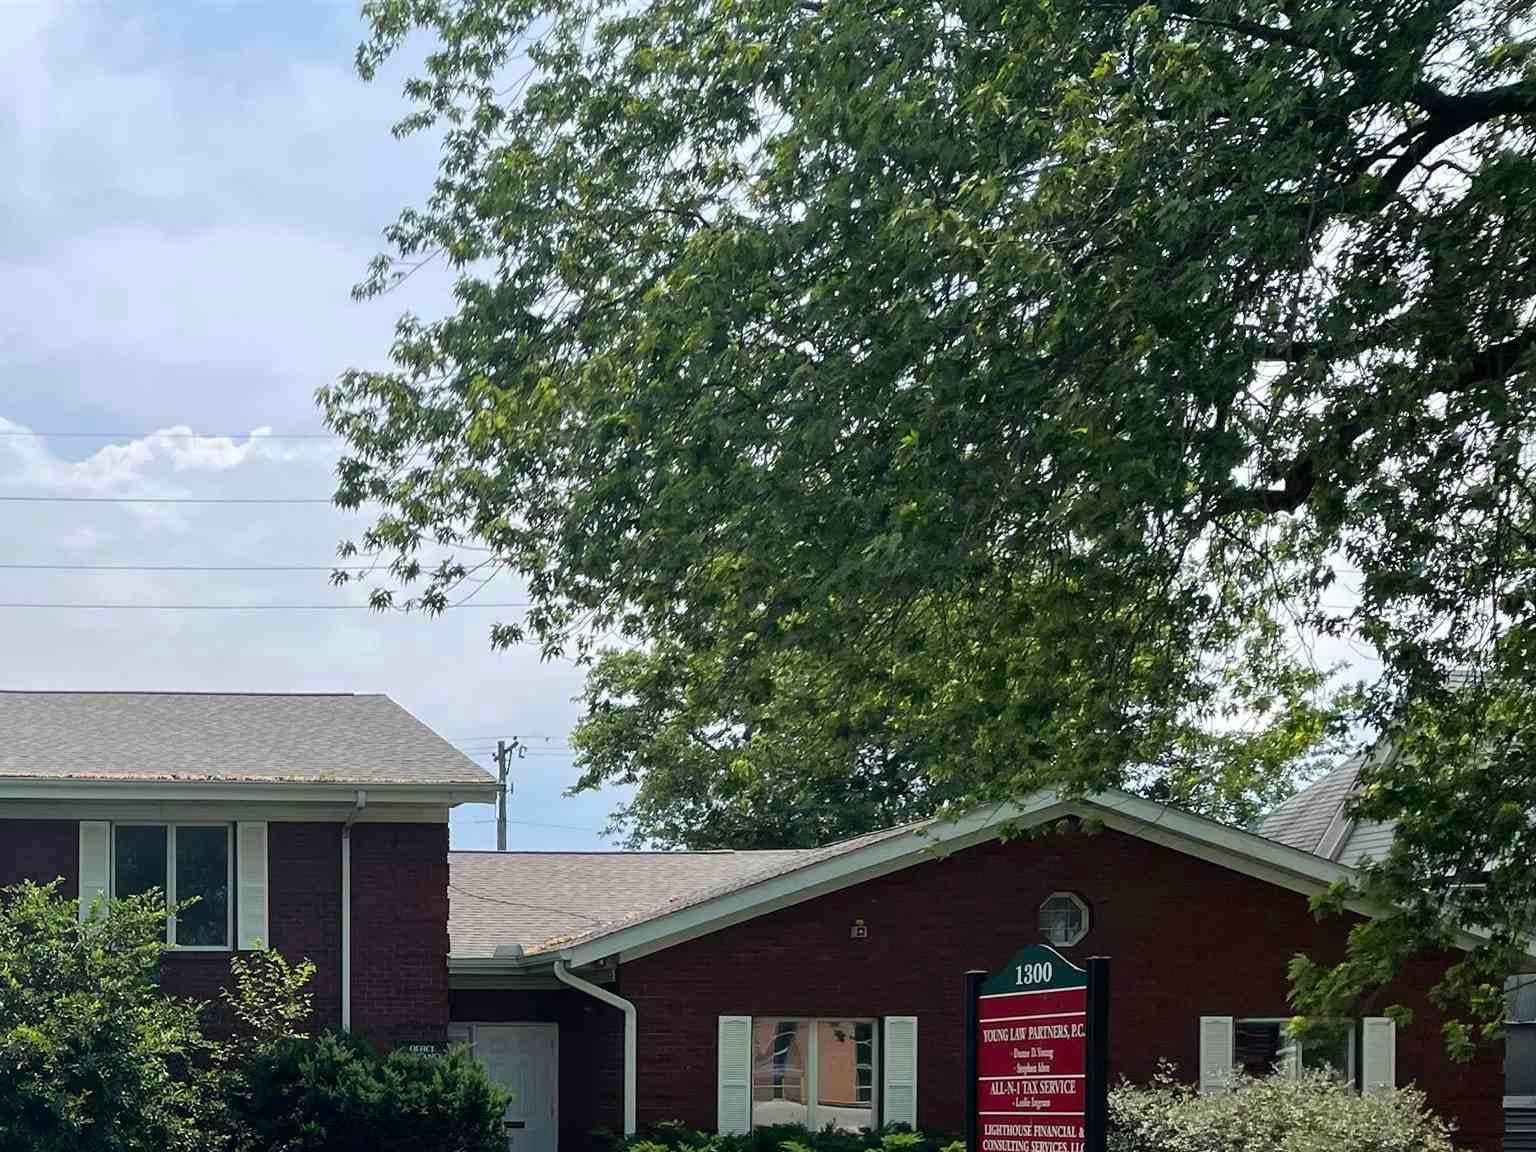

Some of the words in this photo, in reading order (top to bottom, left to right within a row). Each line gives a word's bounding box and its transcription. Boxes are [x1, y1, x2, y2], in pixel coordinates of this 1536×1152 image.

[1015, 961, 1053, 985] 1300
[983, 1028, 1009, 1043] YOUNG
[1010, 1027, 1027, 1041] LAW
[1028, 1024, 1070, 1040] PARTNERS,
[1022, 1080, 1039, 1095] TAX
[1039, 1080, 1076, 1094] SERVICE
[984, 1124, 1033, 1137] LIGHTHOUSE
[1034, 1125, 1077, 1138] FINANCIAL
[982, 1139, 1029, 1152] CONSULTING
